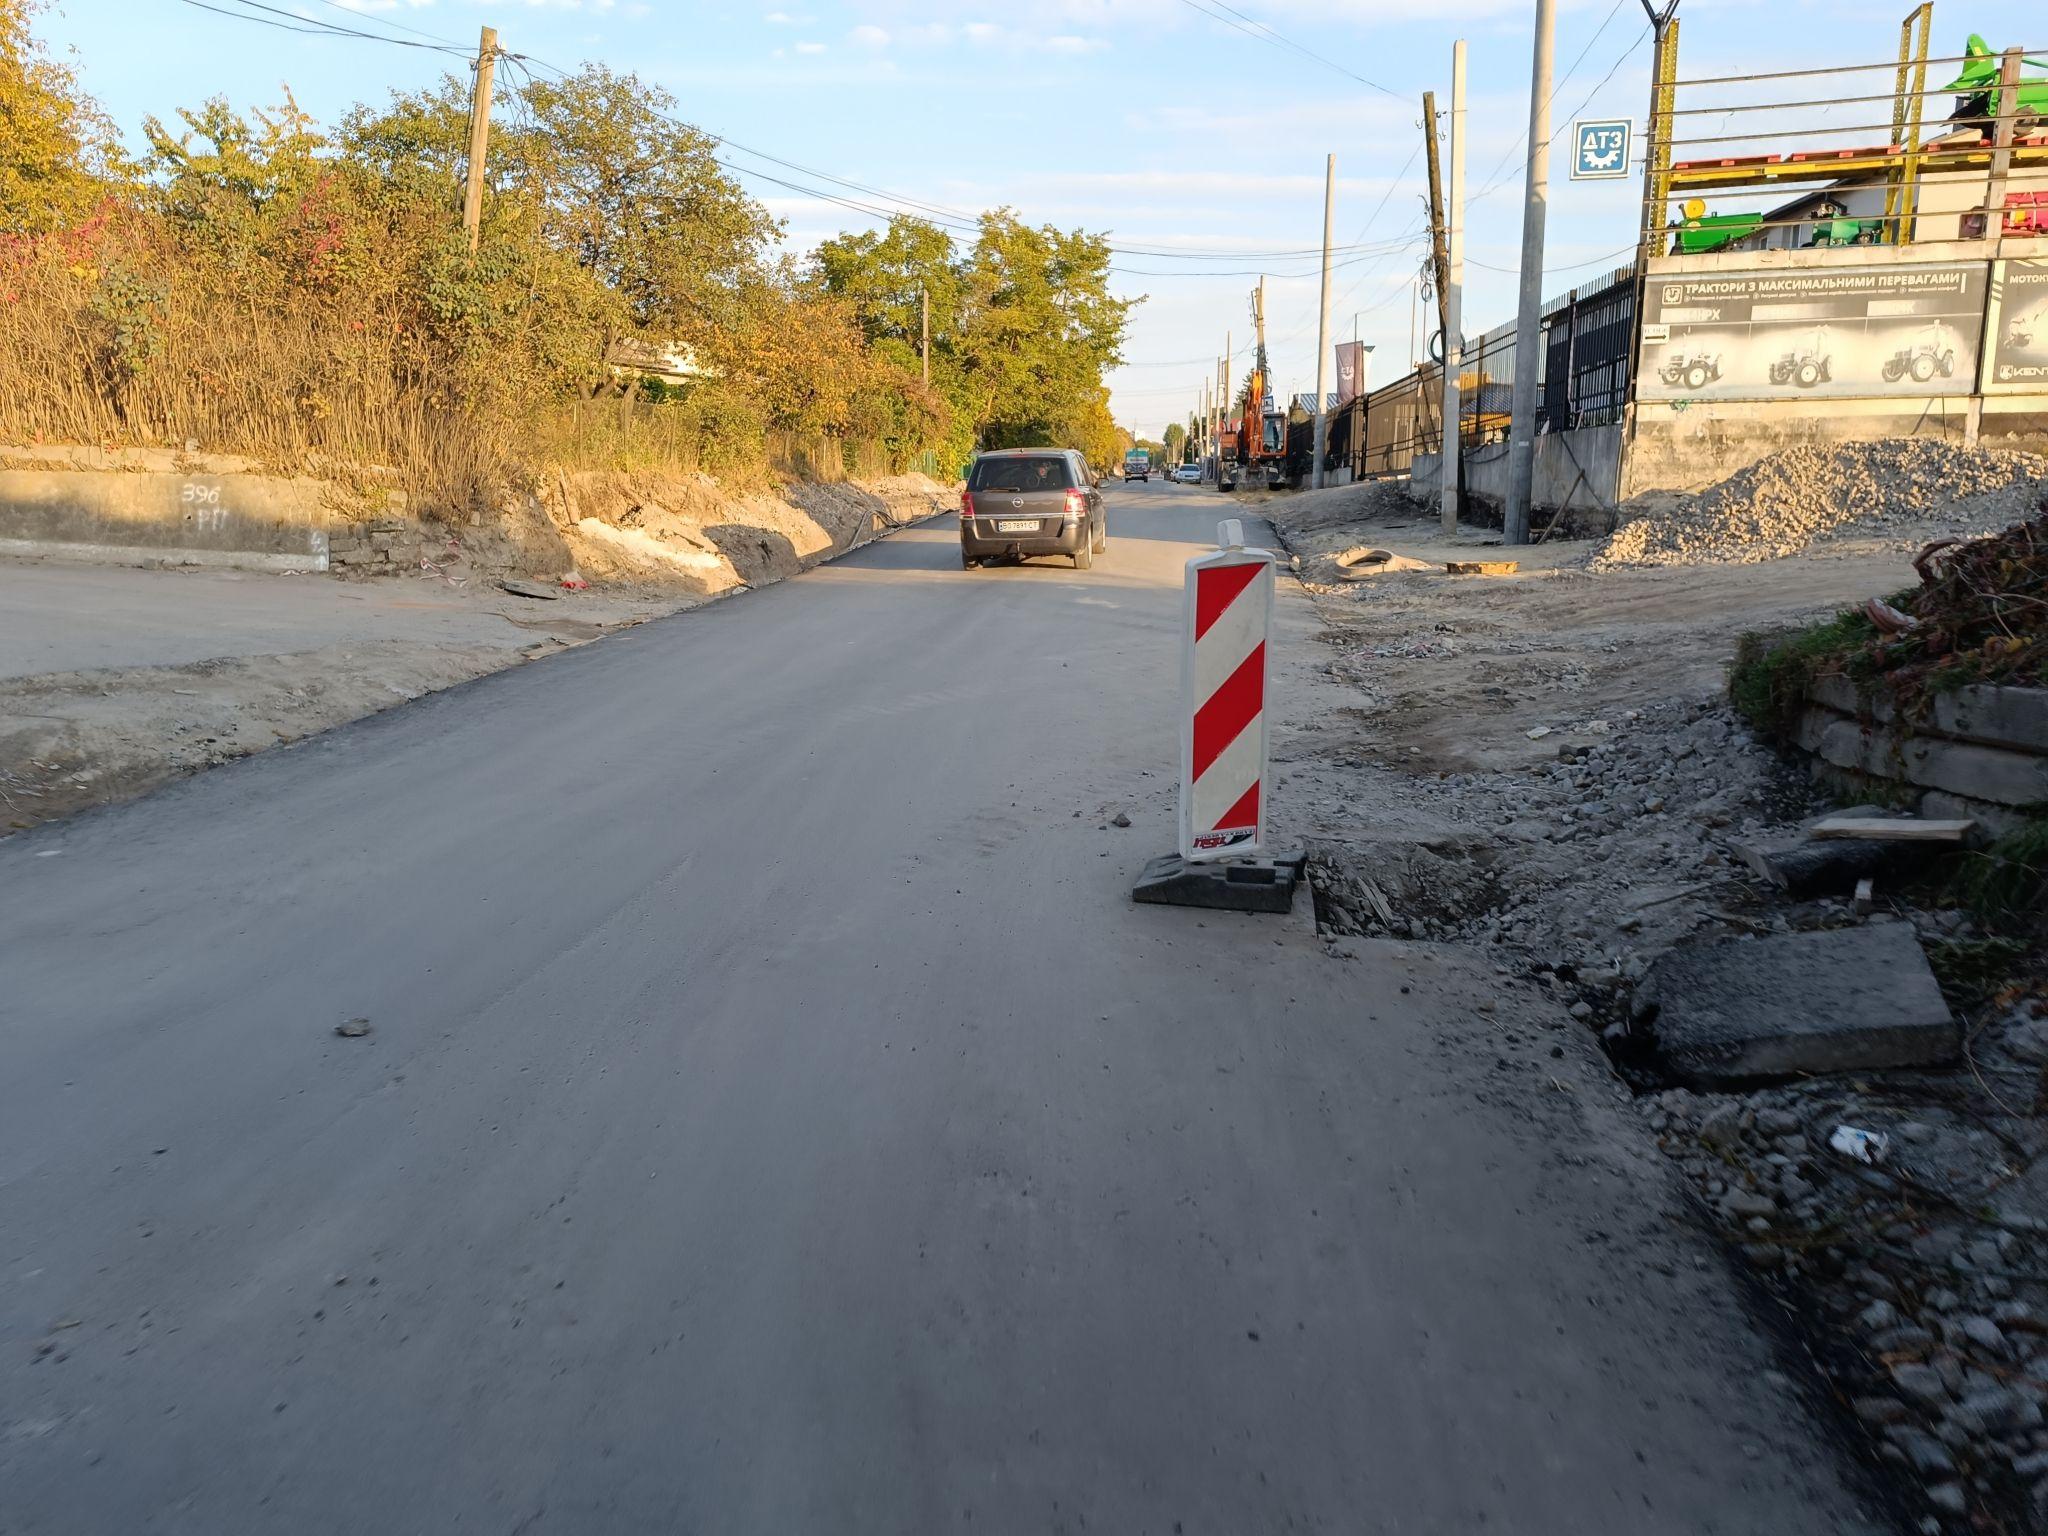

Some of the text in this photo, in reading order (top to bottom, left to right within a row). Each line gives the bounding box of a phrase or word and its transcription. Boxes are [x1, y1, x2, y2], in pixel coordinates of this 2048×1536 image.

[1685, 282, 1746, 294] ТРАКТОРИ
[1758, 277, 1876, 291] МАКСИМАЛЬНИМИ
[1878, 273, 1960, 286] ПЕРЕВАГАМИ
[2009, 274, 2048, 284] МОТОК
[182, 484, 221, 503] 396
